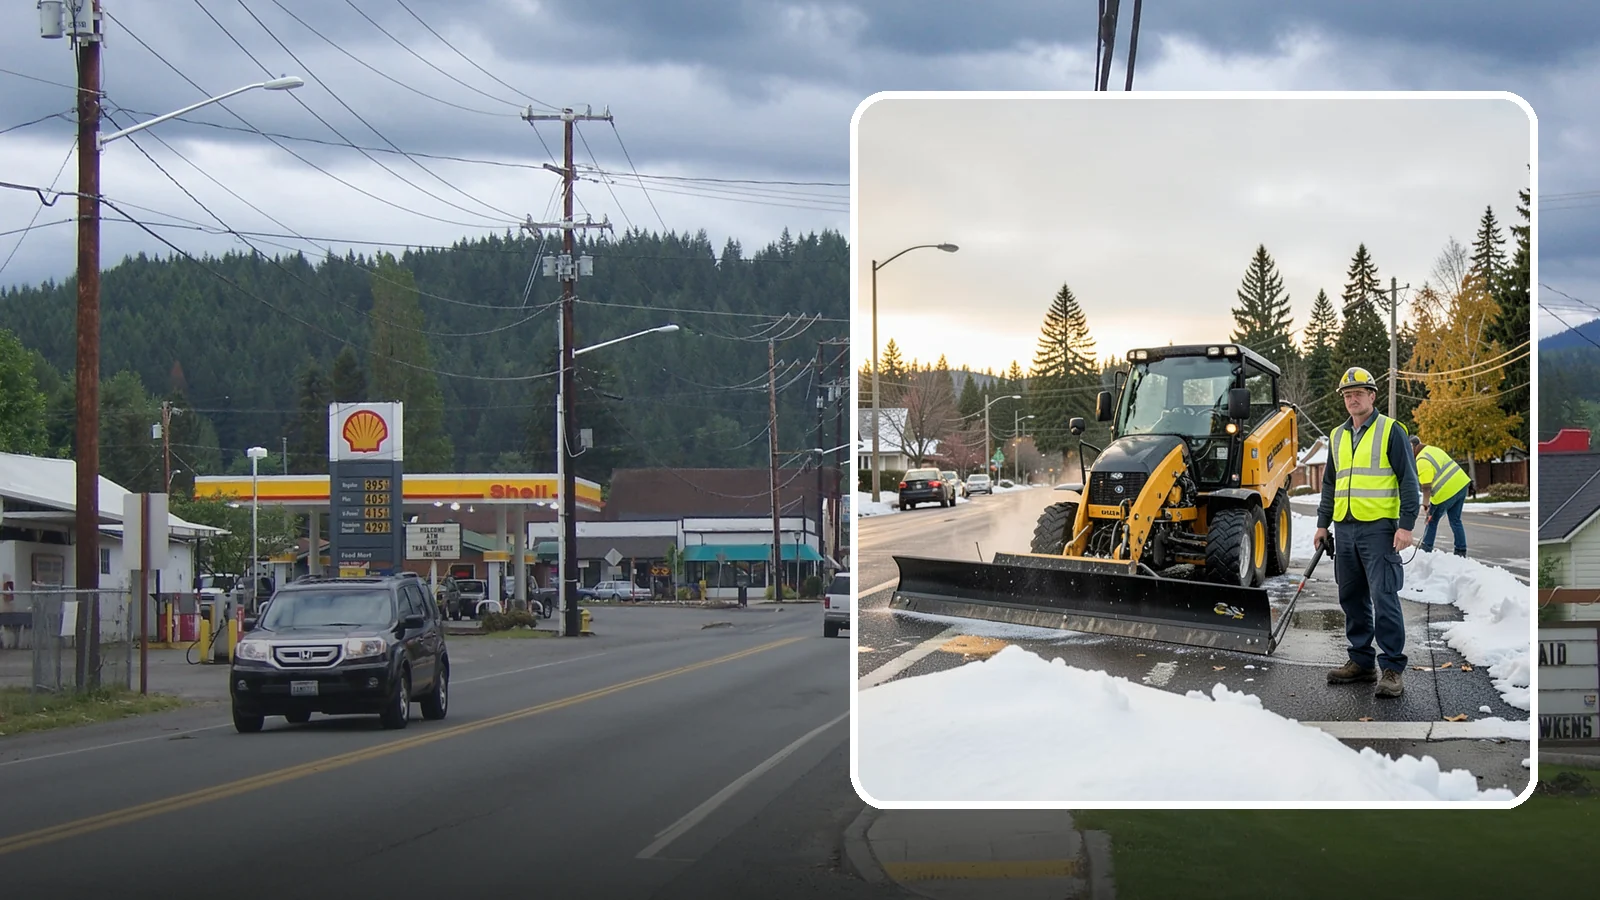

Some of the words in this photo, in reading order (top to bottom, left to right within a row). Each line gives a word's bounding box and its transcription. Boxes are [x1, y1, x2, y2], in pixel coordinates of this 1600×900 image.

[366, 480, 384, 490] 395
[490, 484, 547, 499] Shell
[366, 494, 384, 504] 405
[366, 508, 384, 518] 415
[366, 522, 384, 532] 429
